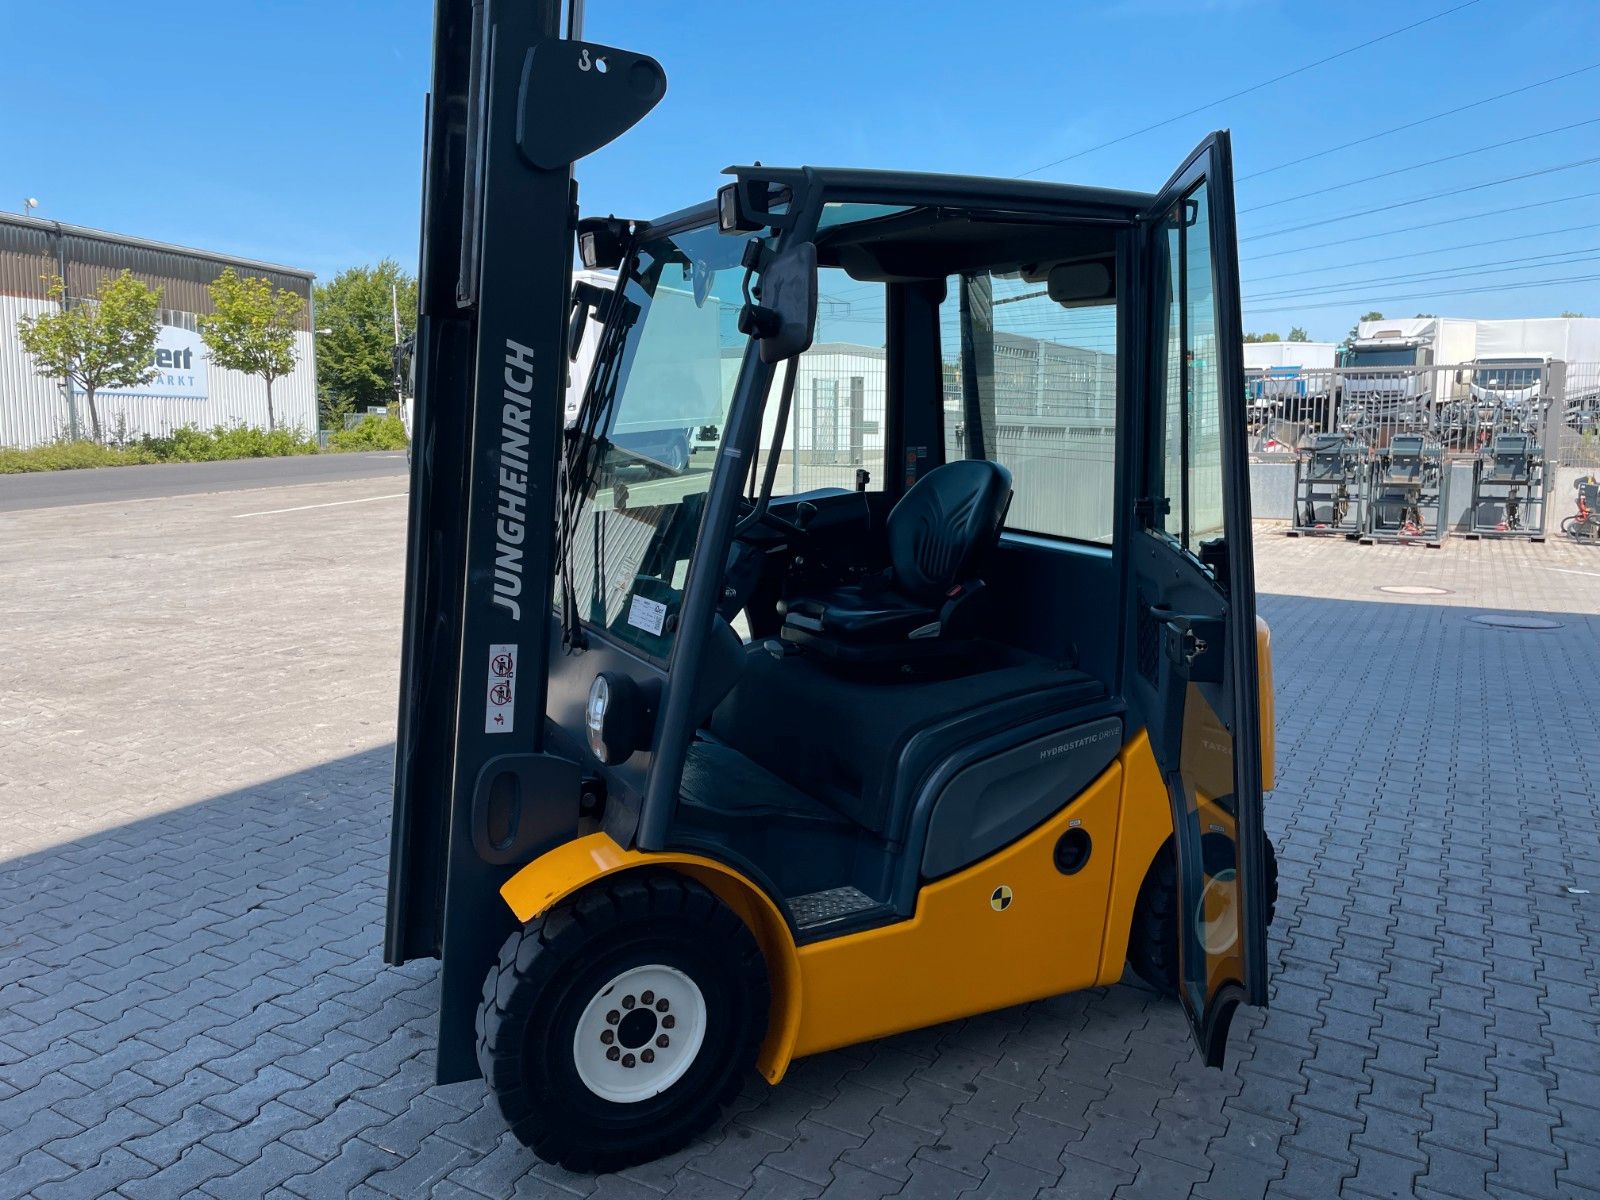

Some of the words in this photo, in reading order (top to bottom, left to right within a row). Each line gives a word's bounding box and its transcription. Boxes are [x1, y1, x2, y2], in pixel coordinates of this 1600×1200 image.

[149, 346, 193, 369] ert
[156, 375, 195, 386] ARKT
[493, 338, 534, 621] JUNGHEINRICH
[1040, 735, 1097, 759] HYDROSTATIC
[1098, 726, 1121, 740] DRIVE
